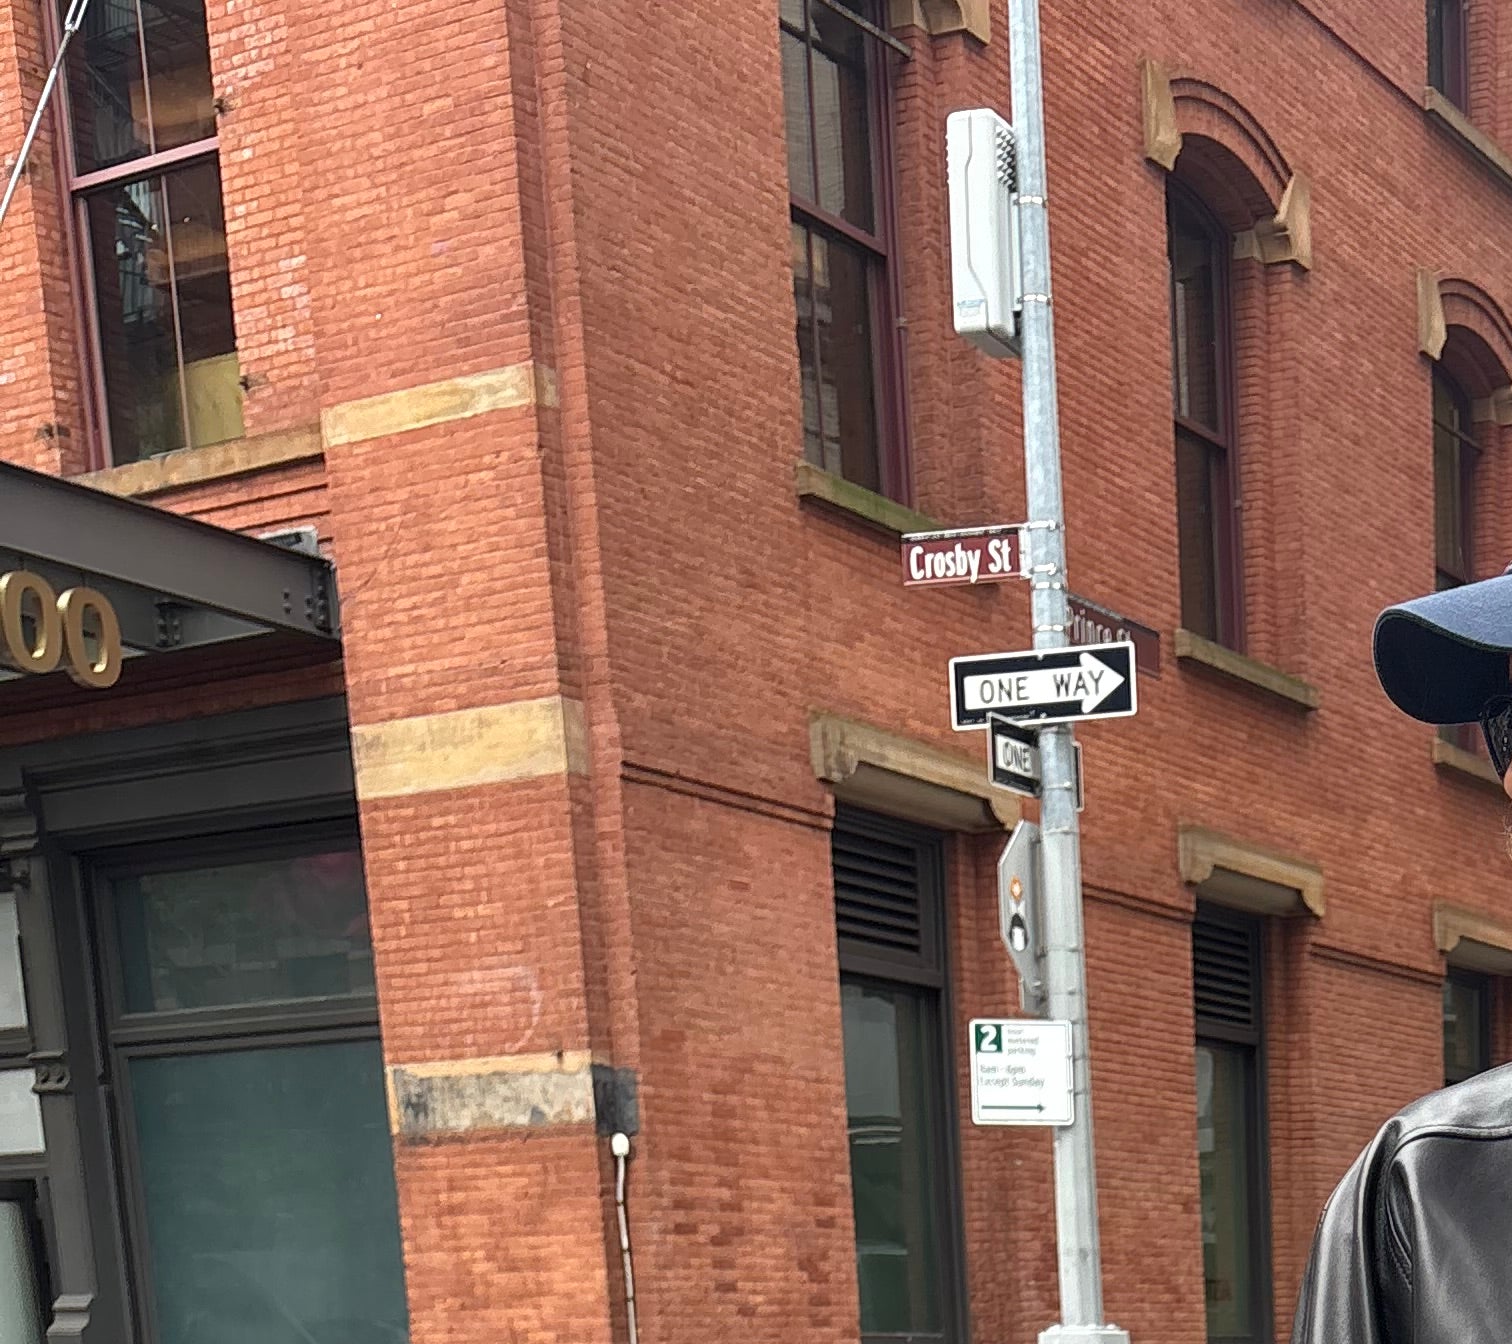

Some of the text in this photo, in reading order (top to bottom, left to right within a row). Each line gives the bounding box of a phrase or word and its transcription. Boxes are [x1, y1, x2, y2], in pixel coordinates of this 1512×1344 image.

[909, 538, 1012, 584] Crosby St
[979, 669, 1105, 705] ONE WAY
[1002, 741, 1032, 772] ONE
[980, 1025, 997, 1051] 2
